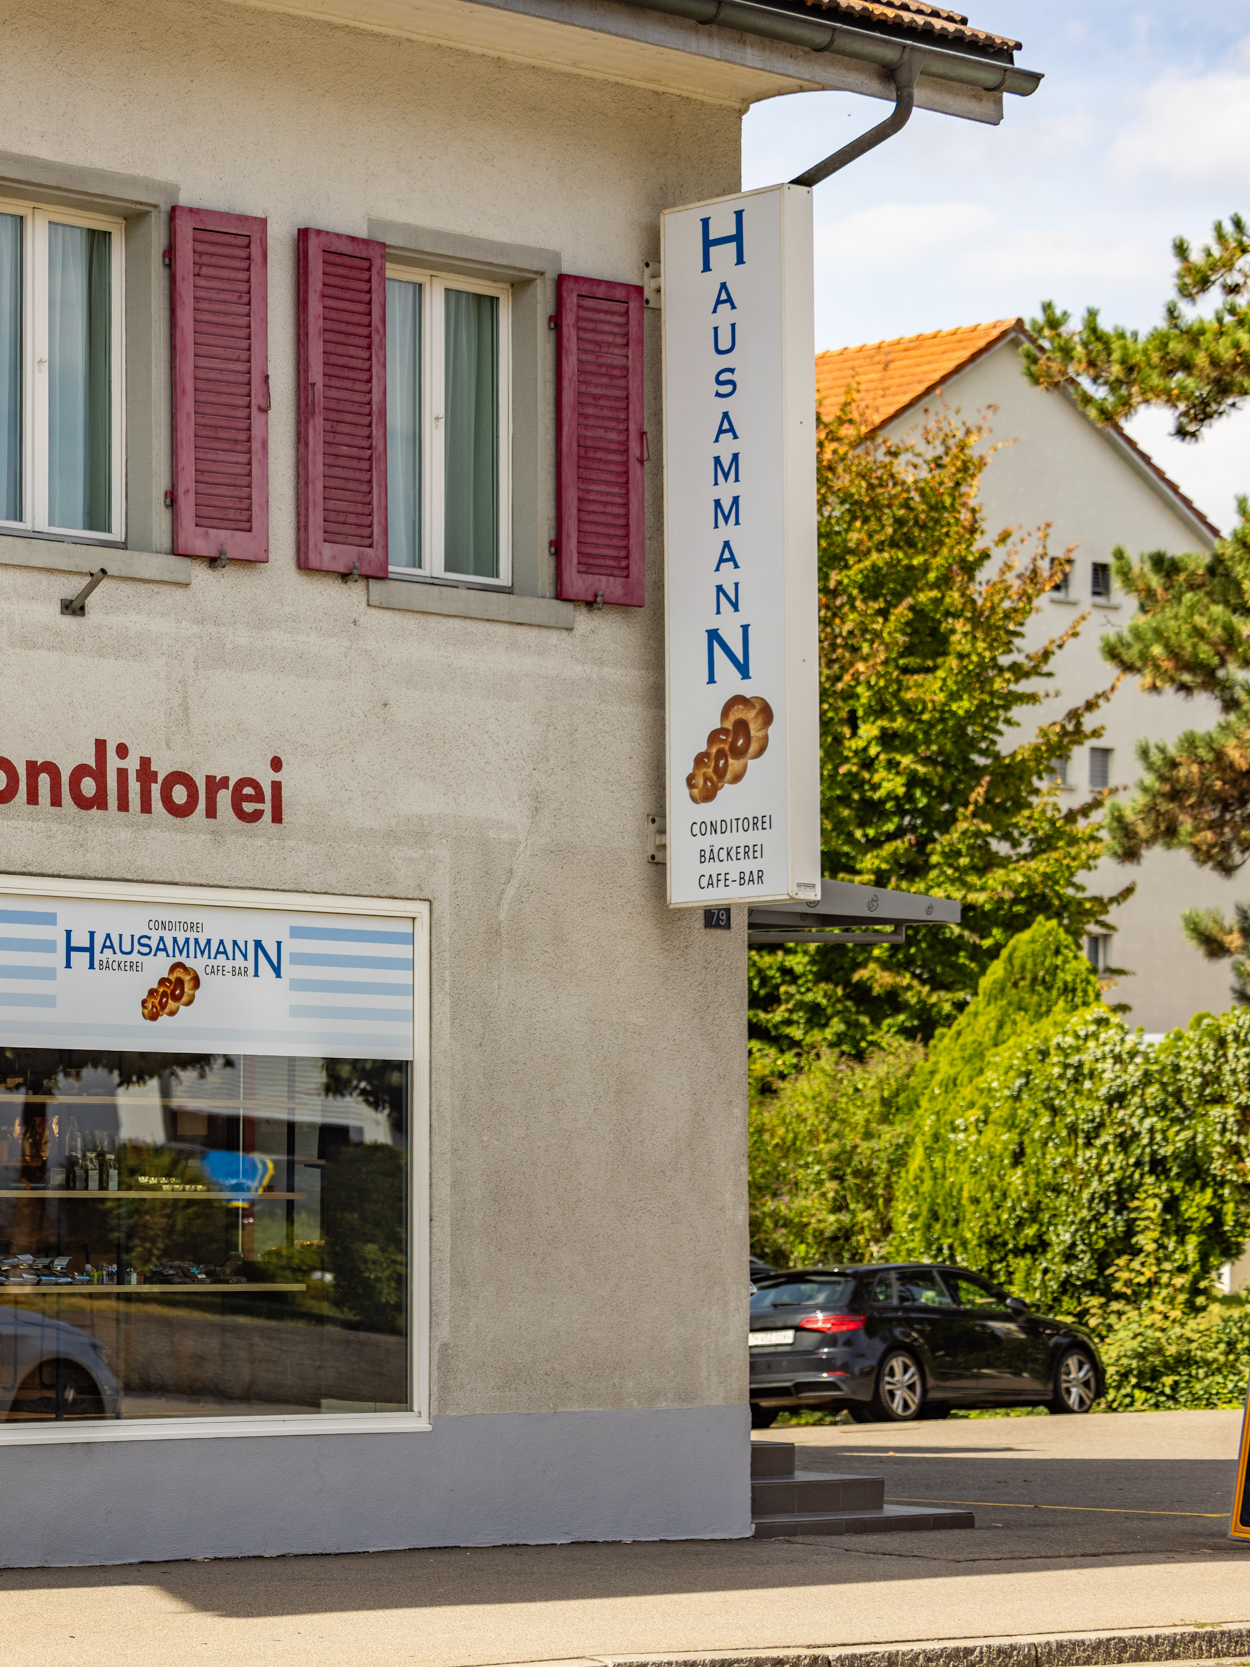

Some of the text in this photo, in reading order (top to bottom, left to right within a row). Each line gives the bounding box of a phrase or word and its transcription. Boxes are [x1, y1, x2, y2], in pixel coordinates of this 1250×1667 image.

[700, 209, 752, 685] HAUSAMMANN
[690, 814, 773, 838] CONDITOREI
[699, 843, 764, 865] BÄCKEREI
[698, 869, 765, 890] CAFE-BAR
[147, 919, 205, 933] CONDITOREI
[710, 909, 727, 926] 79
[64, 929, 283, 979] HAUSAMMANN
[98, 958, 144, 974] BÄCKEREI
[204, 963, 249, 978] CAFE-BAR
